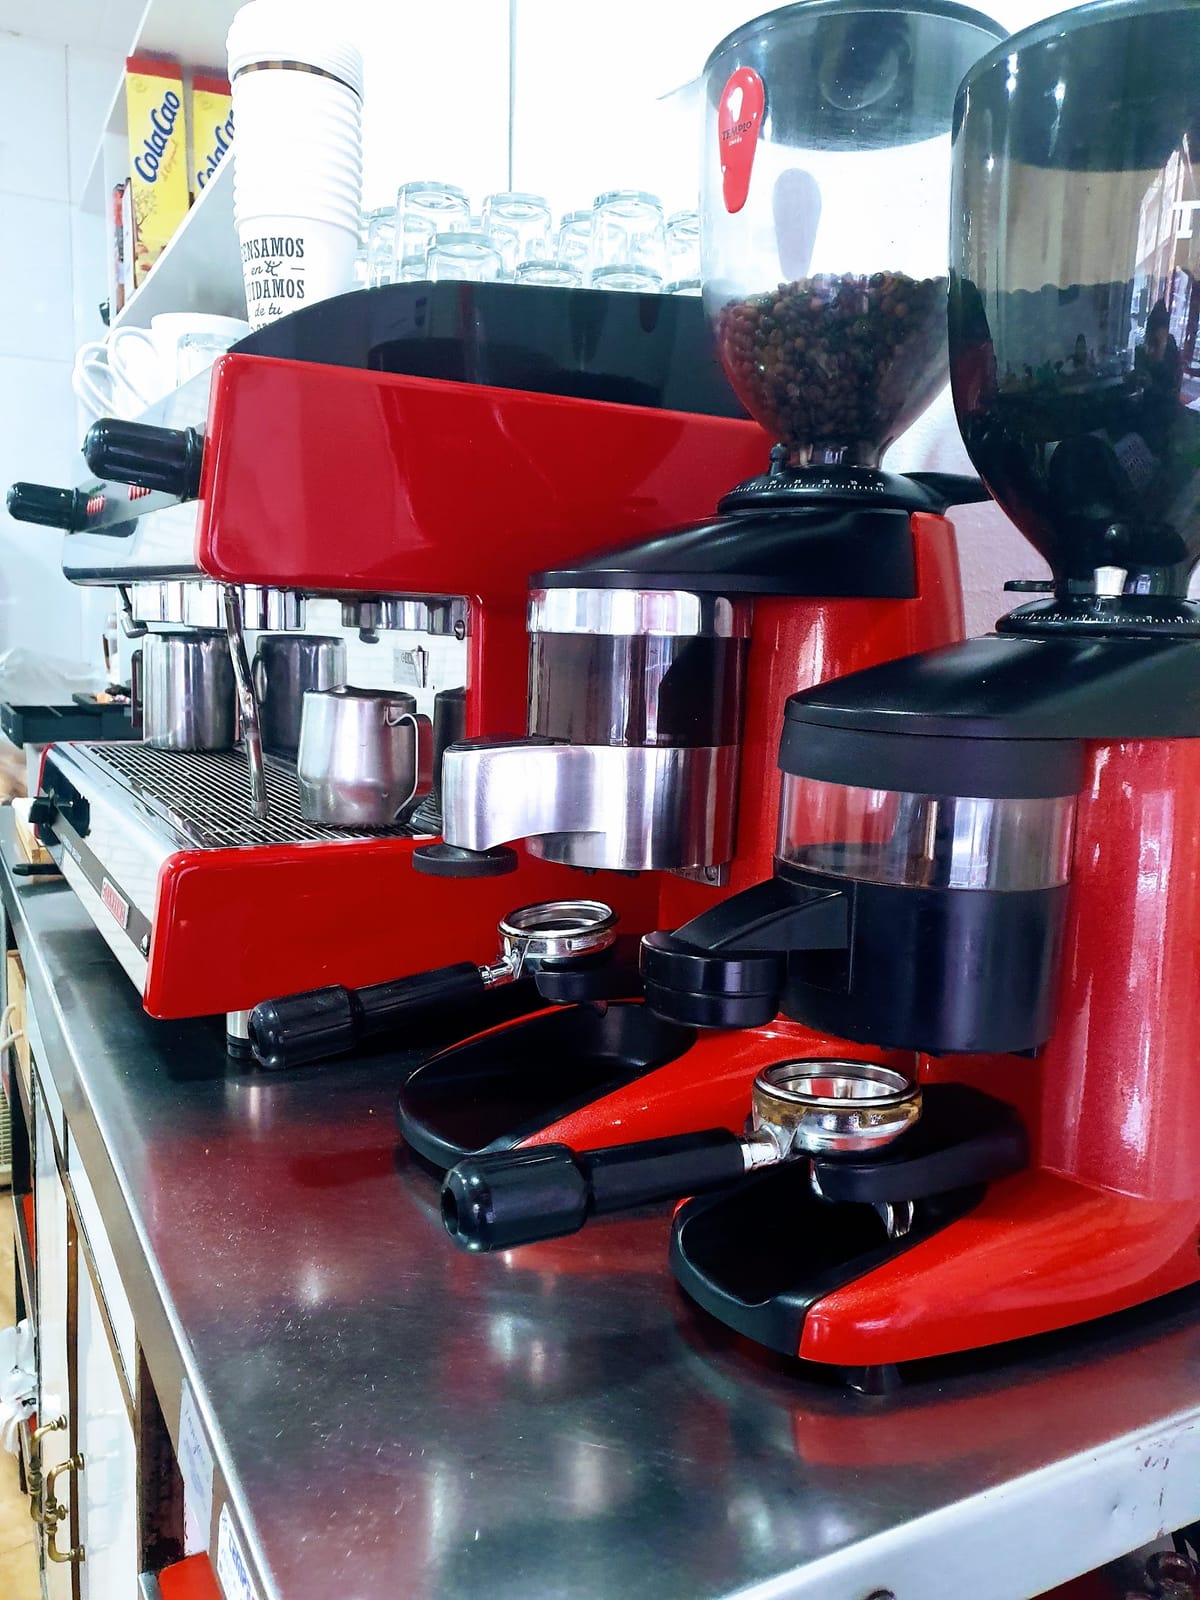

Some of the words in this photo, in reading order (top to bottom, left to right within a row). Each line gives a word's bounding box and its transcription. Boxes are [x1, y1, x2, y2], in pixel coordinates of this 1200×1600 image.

[134, 91, 180, 183] ColaCao
[241, 237, 304, 262] ENSAMOS
[251, 265, 263, 276] en
[254, 302, 265, 317] de
[268, 302, 283, 315] tu
